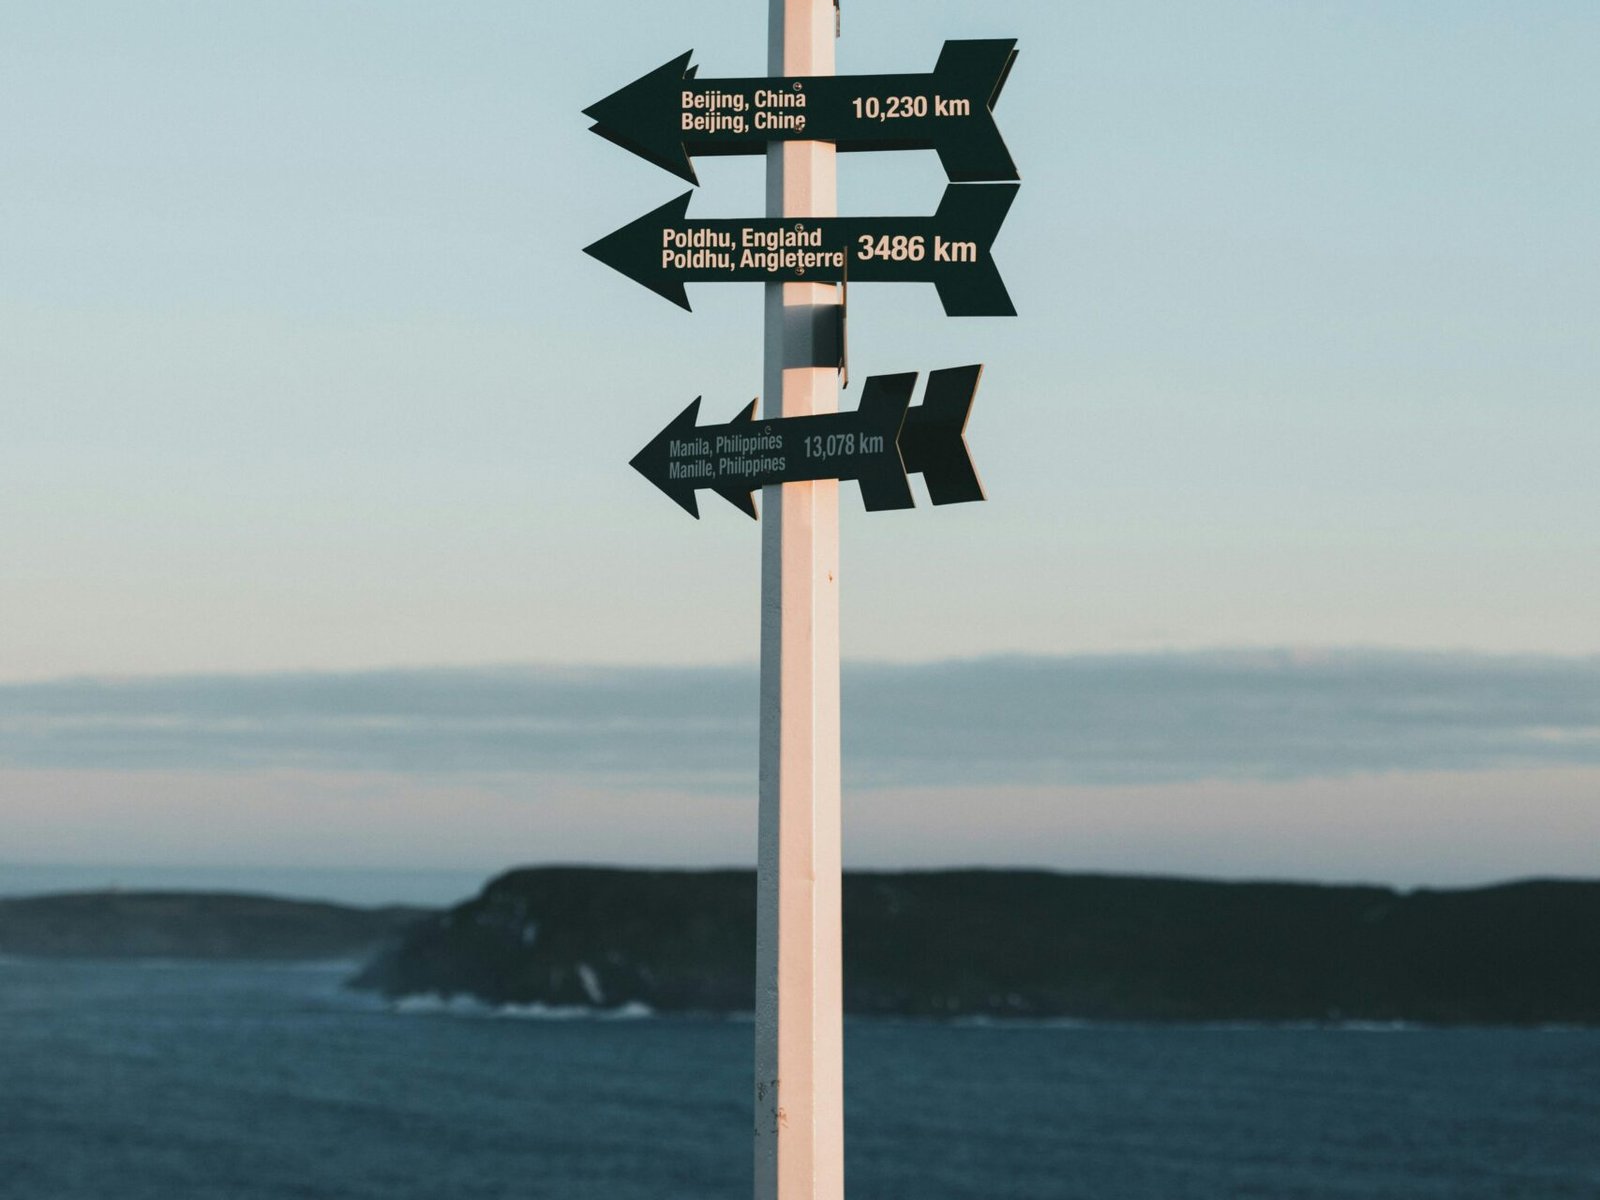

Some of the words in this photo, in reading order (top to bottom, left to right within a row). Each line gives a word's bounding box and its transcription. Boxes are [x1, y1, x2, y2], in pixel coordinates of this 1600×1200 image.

[681, 90, 749, 112] Beijing,
[754, 90, 806, 109] China
[852, 96, 928, 122] 10,230
[934, 95, 971, 117] km
[681, 113, 749, 134] Beijing,
[754, 112, 806, 131] Chine
[662, 229, 737, 250] Poldhu,
[742, 227, 822, 251] England
[857, 235, 925, 262] 3486
[934, 235, 977, 263] km
[662, 250, 735, 272] Poldhu,
[739, 249, 844, 272] Angleterre
[669, 438, 713, 458] Manila,
[715, 433, 783, 455] Philippines
[804, 434, 855, 462] 13,078
[859, 432, 884, 454] km
[669, 459, 716, 480] Manille,
[719, 455, 786, 477] Philippines
